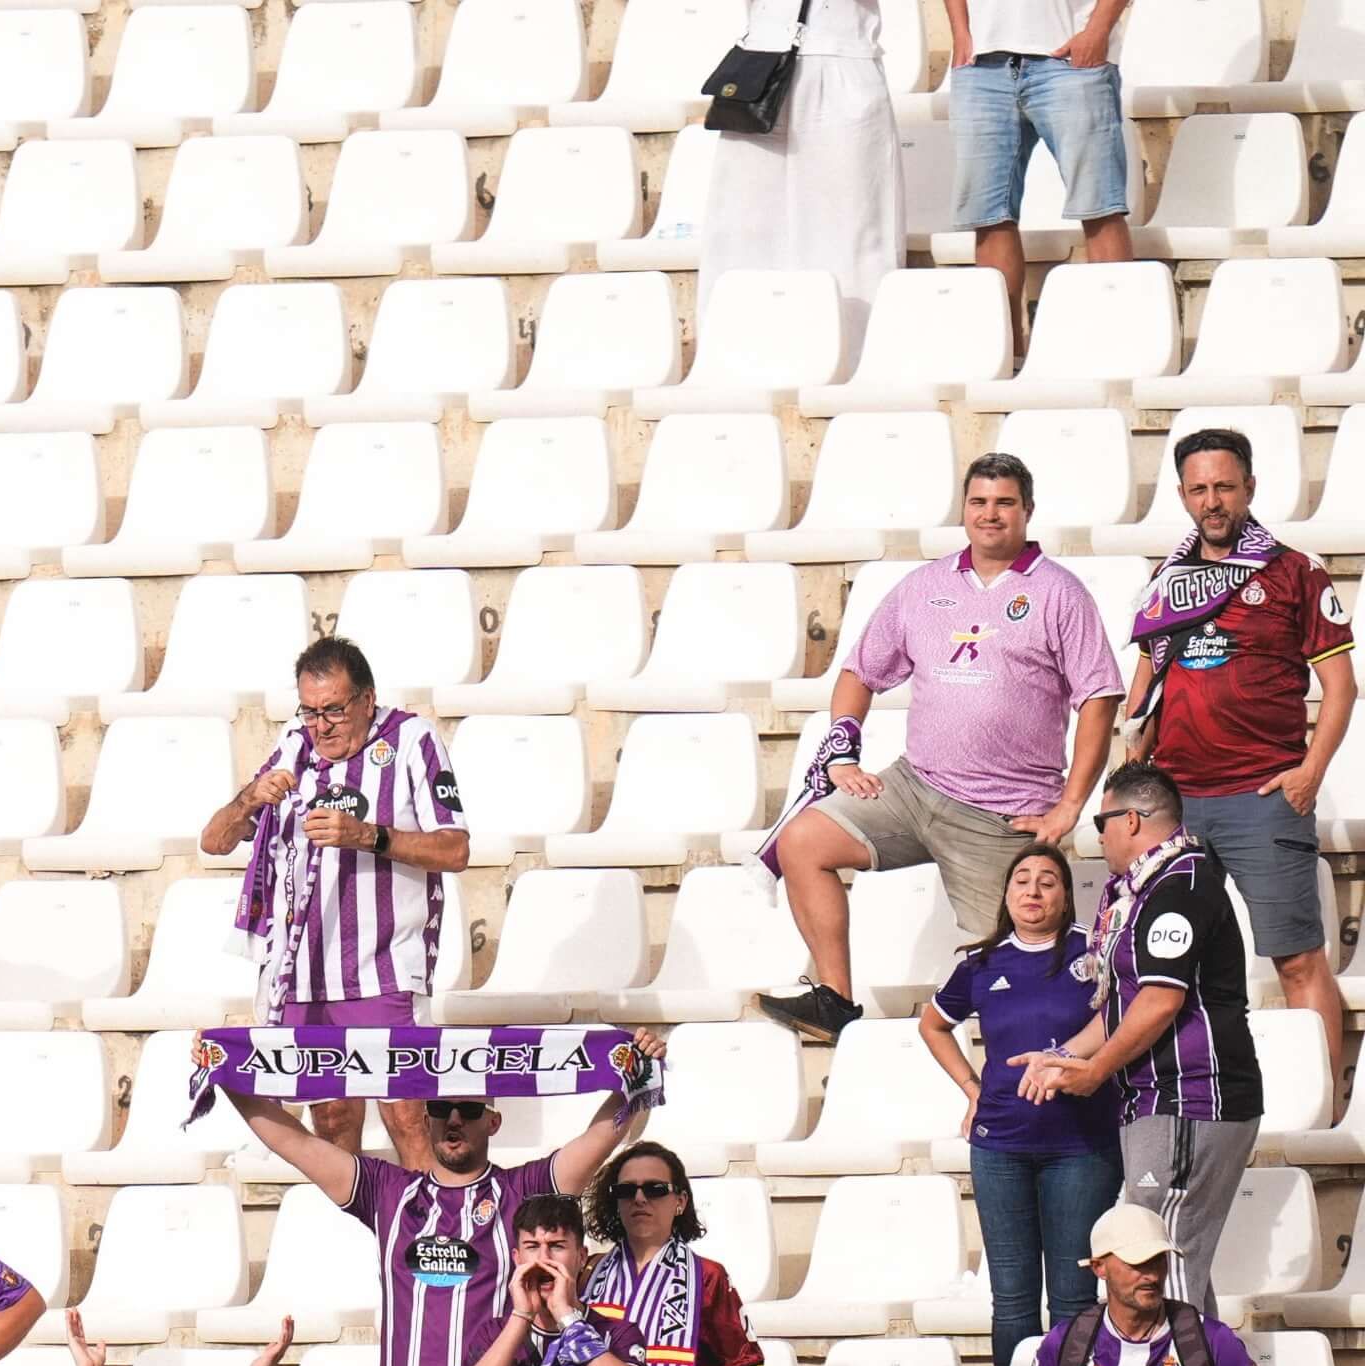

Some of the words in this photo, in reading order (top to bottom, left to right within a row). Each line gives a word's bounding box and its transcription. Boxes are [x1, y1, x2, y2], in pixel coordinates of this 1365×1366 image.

[1151, 929, 1188, 945] DIGI
[237, 1043, 374, 1077] AÚPA
[386, 1041, 594, 1077] PUCELA
[416, 1243, 468, 1259] Estrella
[419, 1257, 466, 1273] Galicia
